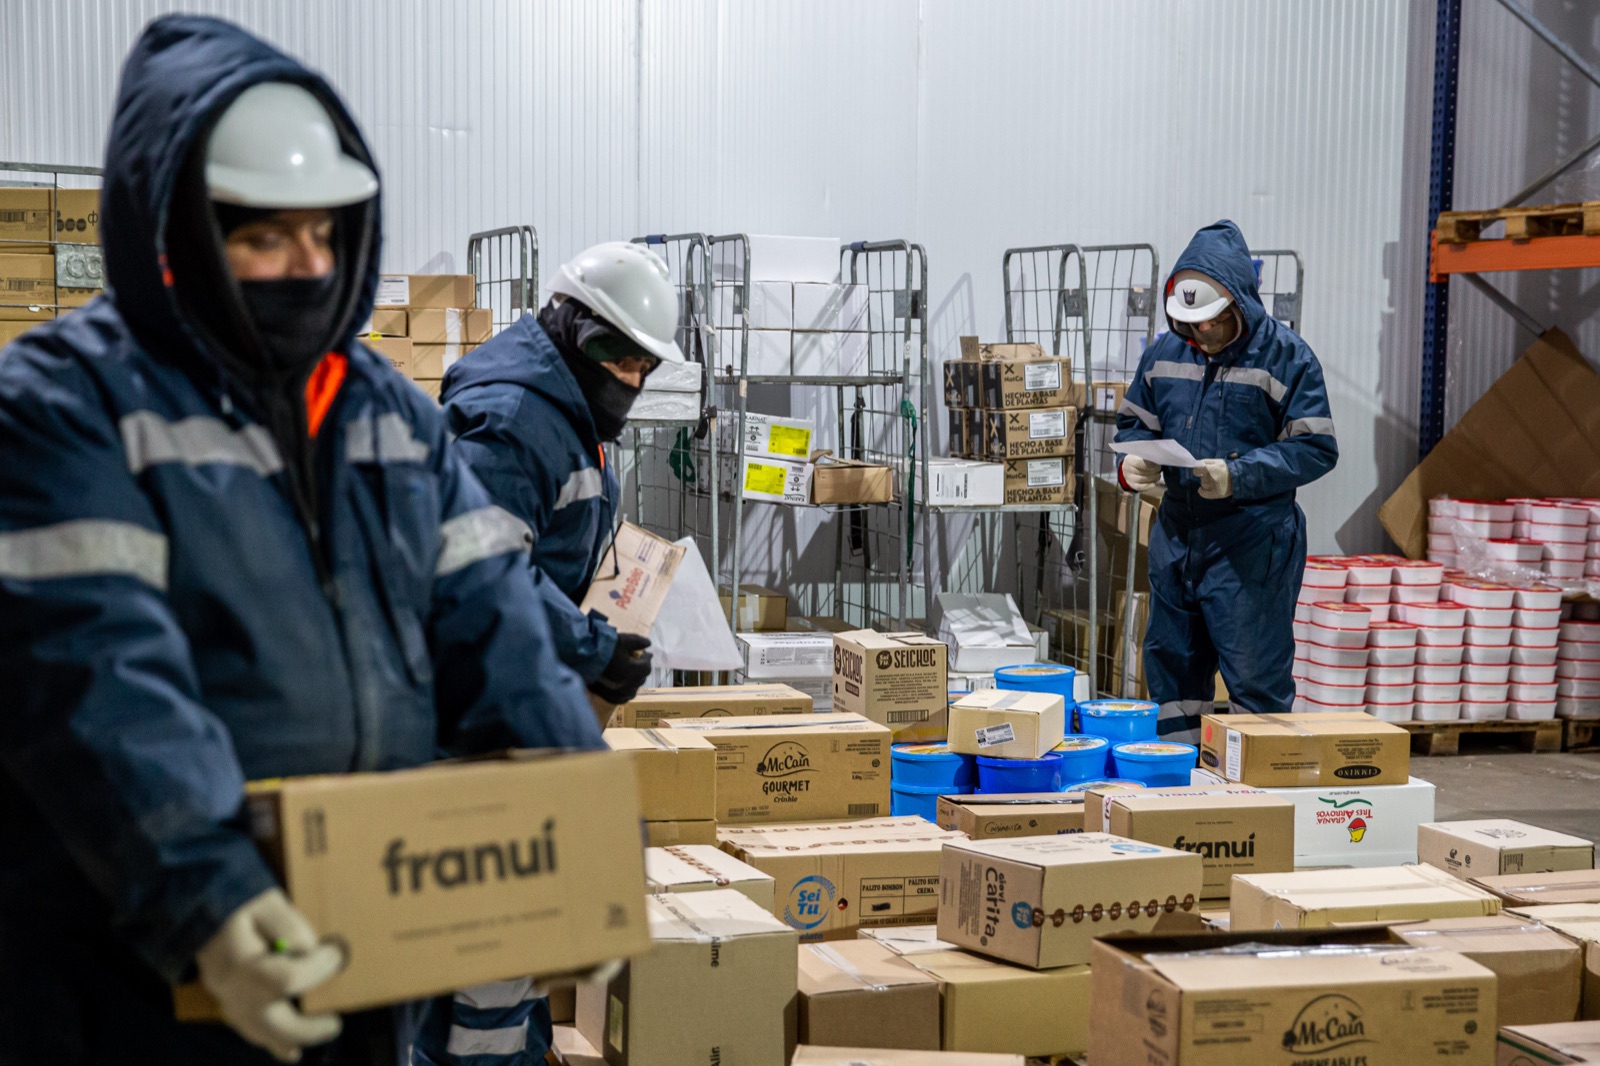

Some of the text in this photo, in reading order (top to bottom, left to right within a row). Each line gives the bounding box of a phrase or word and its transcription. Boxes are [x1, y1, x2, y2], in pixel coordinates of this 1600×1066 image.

[1005, 389, 1058, 399] HECHO A BASE
[1005, 397, 1049, 407] DE PLANTAS
[1010, 439, 1063, 449] HECHO A BASE
[1021, 446, 1054, 455] PLANTAS
[1006, 487, 1061, 497] HECHO A BASE
[1019, 494, 1052, 502] PLANTAS
[894, 648, 936, 669] SEICHOC
[766, 754, 810, 773] McCain
[1337, 767, 1378, 777] CIMMINO
[762, 780, 811, 795] GOURMET
[773, 795, 798, 803] Crinkle
[1316, 808, 1373, 820] TRES ARROYOS
[381, 817, 558, 896] franui
[862, 883, 903, 892] PALITO BOMBON
[908, 878, 927, 887] PALITO
[798, 888, 821, 902] Sei
[798, 902, 820, 915] Tu
[1299, 1016, 1366, 1047] McCain
